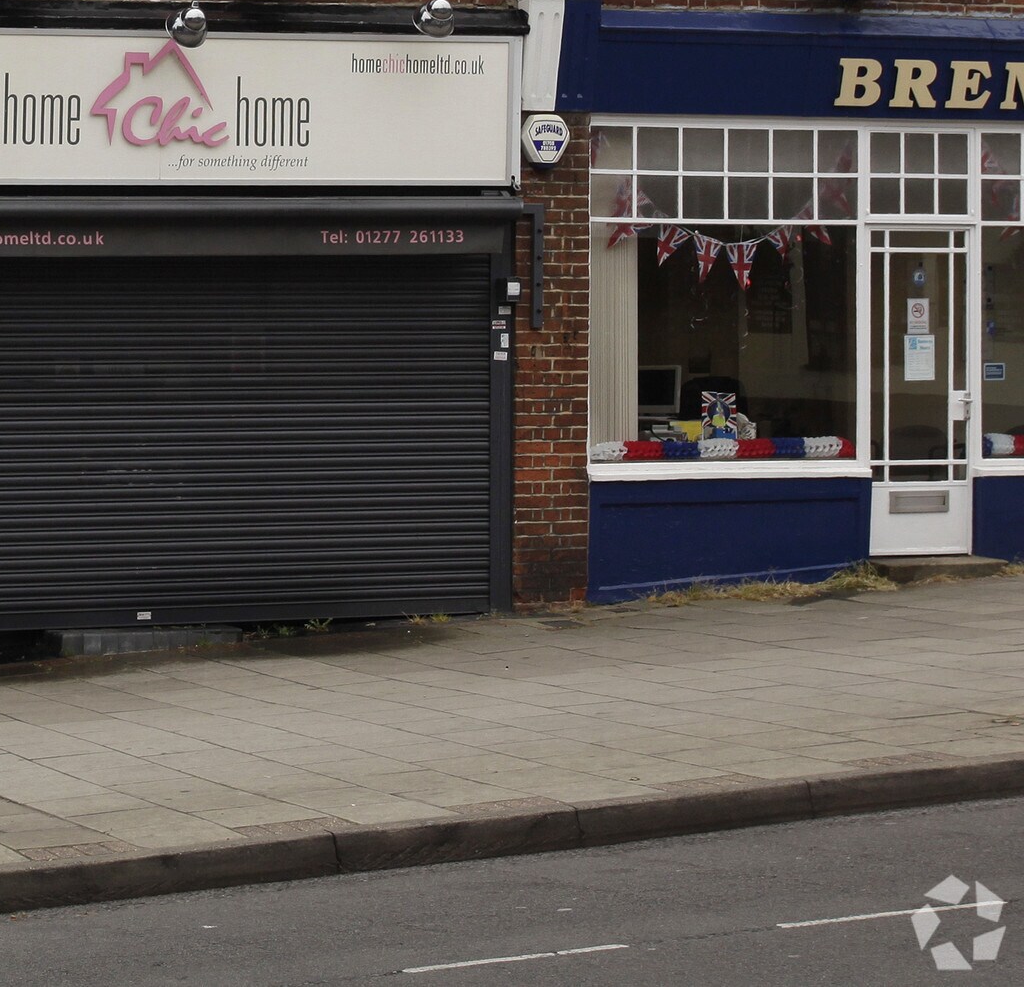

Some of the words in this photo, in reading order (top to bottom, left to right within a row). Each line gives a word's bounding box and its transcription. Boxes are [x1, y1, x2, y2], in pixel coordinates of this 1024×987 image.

[351, 53, 485, 75] homechichomeltd.co.uk
[2, 72, 81, 145] home
[121, 95, 230, 148] Chic
[236, 76, 311, 147] home
[535, 123, 564, 137] SAFEGUARD
[198, 155, 258, 171] something
[260, 155, 309, 172] different
[320, 230, 348, 244] Tel:
[355, 229, 401, 244] 01277
[409, 229, 465, 243] 261133
